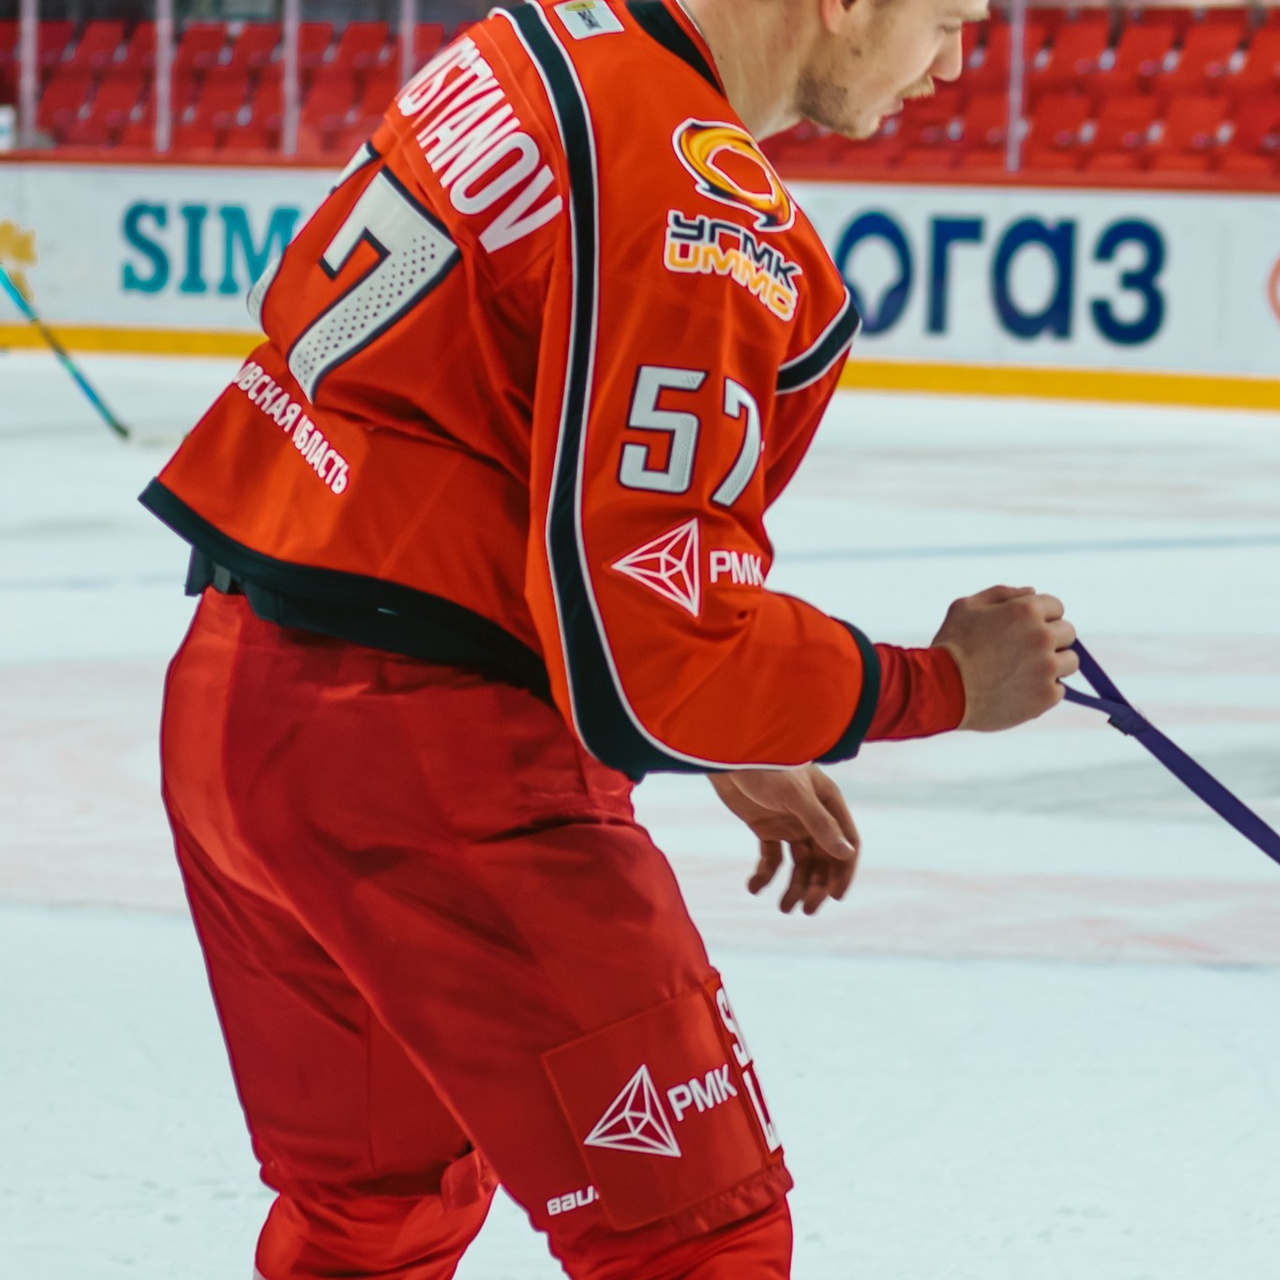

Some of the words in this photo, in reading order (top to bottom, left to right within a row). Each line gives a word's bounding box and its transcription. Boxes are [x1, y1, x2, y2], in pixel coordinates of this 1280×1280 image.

[394, 32, 564, 254] STYANOV
[247, 139, 462, 406] 7
[667, 211, 801, 293] УГМК
[619, 364, 765, 509] 57
